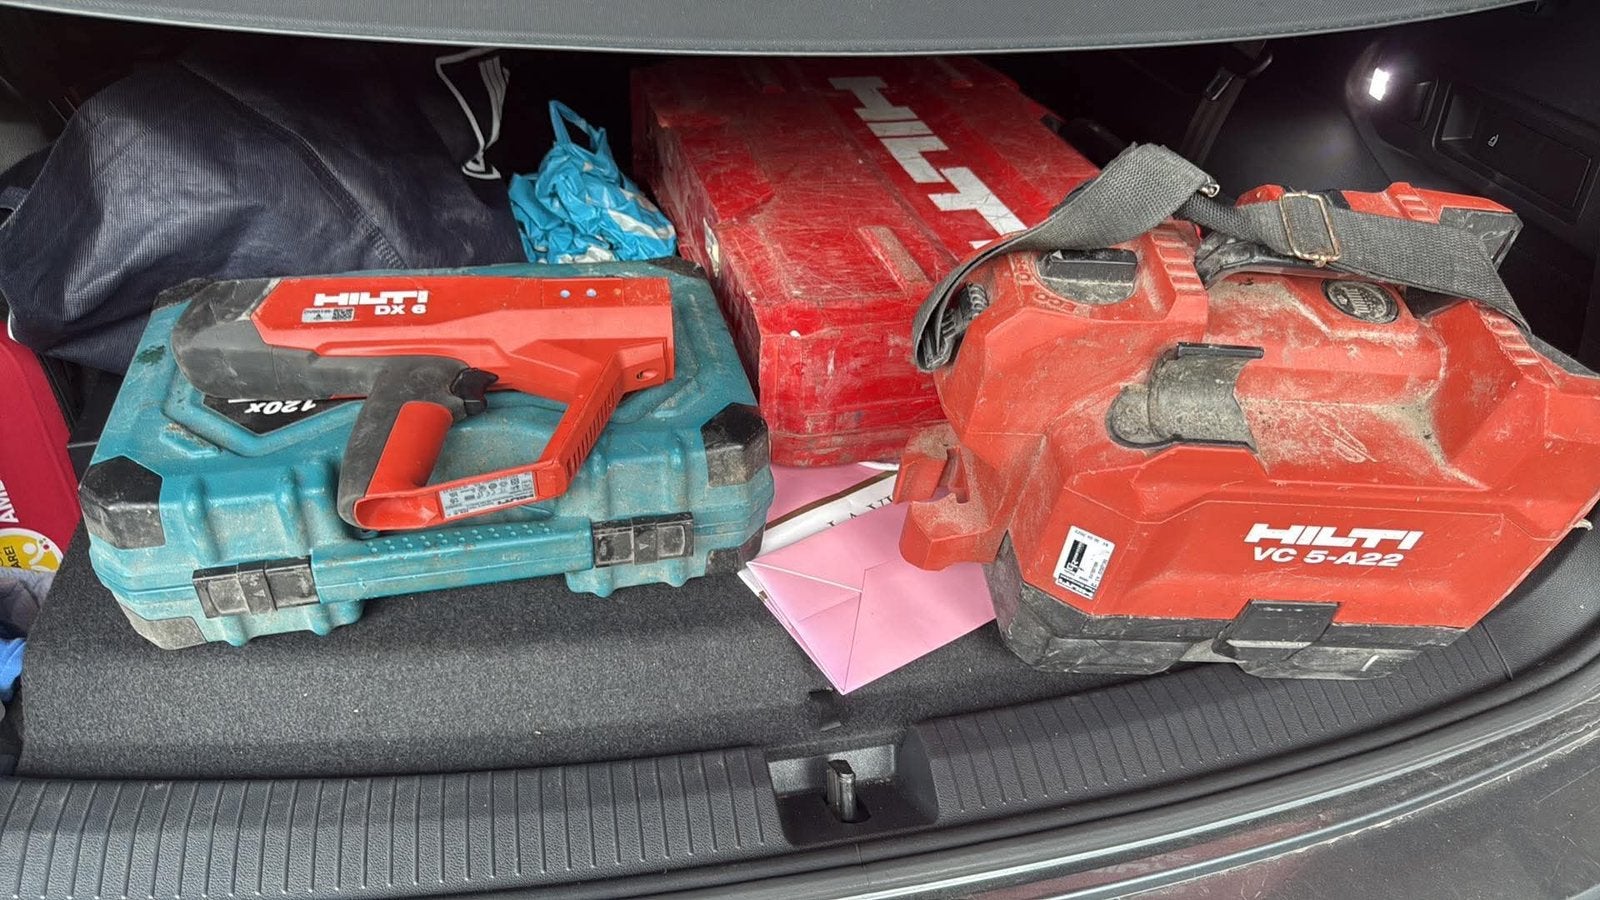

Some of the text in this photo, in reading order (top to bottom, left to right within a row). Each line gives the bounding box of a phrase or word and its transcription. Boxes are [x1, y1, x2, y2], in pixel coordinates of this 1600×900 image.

[828, 76, 1028, 250] HILT
[314, 290, 428, 307] HILTI
[374, 304, 427, 316] DX 6
[243, 399, 316, 415] 120x
[1244, 522, 1424, 550] HILTI
[1253, 546, 1404, 567] VC 5-A22
